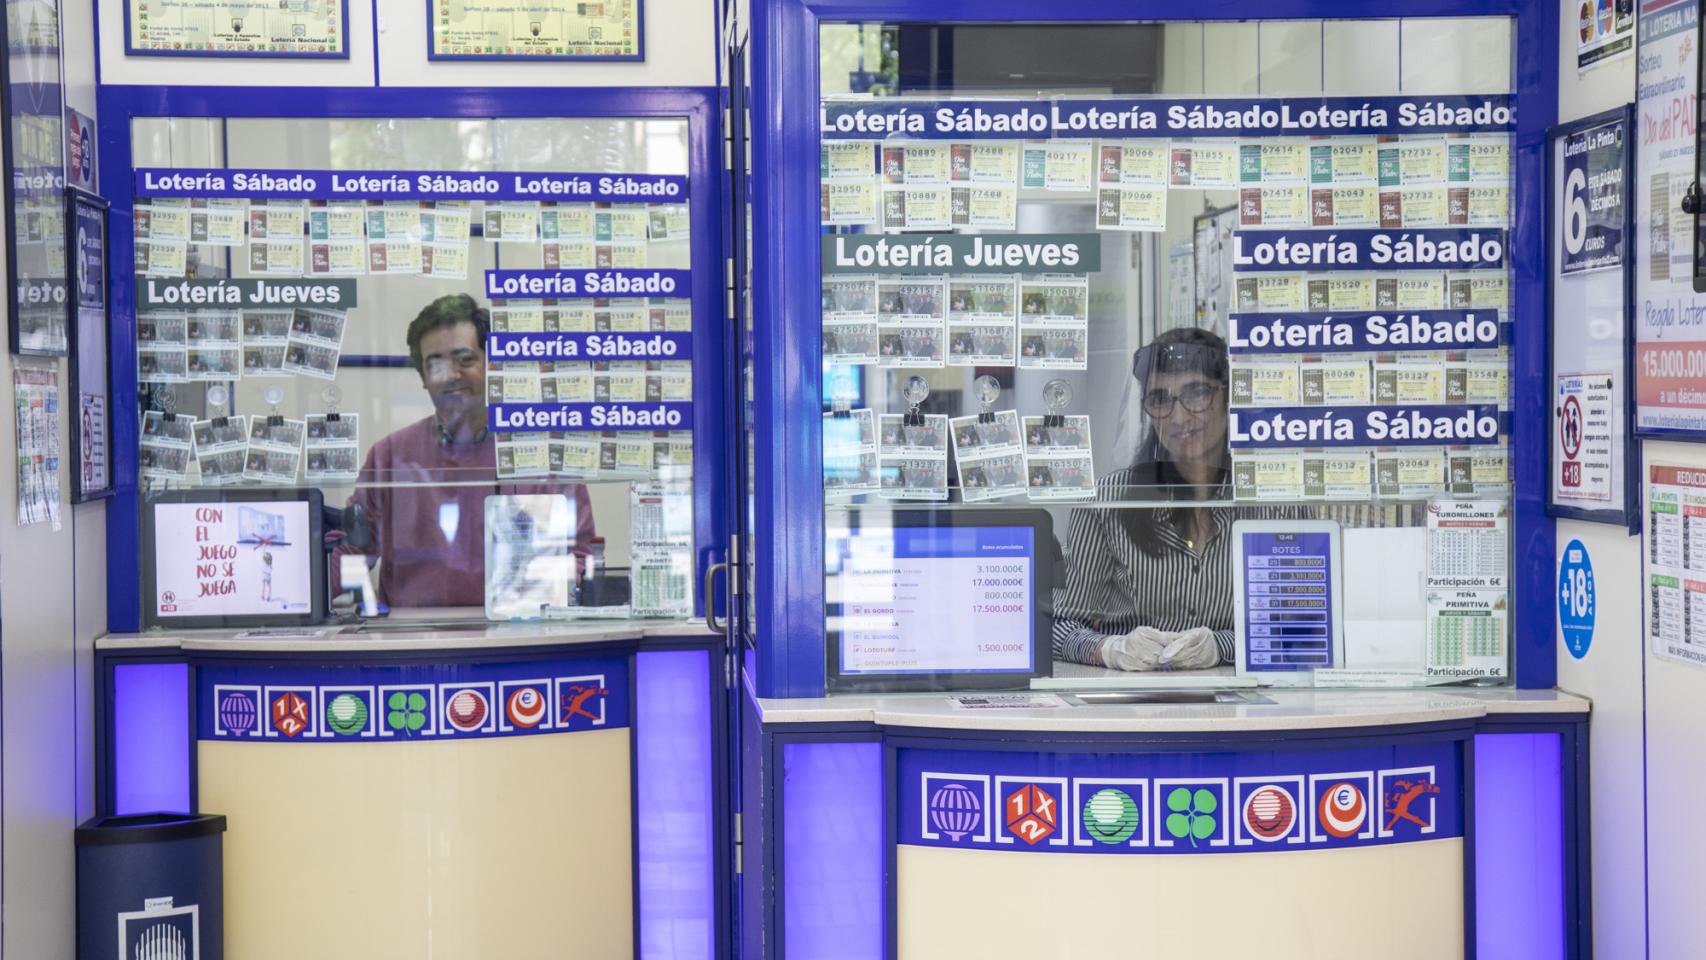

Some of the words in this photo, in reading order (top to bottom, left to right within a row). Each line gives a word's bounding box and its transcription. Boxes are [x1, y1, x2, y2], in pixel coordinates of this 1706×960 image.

[820, 108, 925, 132] Lotería
[935, 108, 1048, 132] Sábado
[1052, 105, 1157, 130] Lotería
[1166, 104, 1279, 130] Sábado
[1281, 104, 1388, 128] Lotería
[1398, 102, 1511, 126] Sábado
[1588, 136, 1596, 150] La
[1597, 131, 1614, 148] Pinta
[906, 148, 936, 157] 10889
[1046, 152, 1078, 160] 40217
[1262, 146, 1293, 154] 67414
[145, 172, 226, 191] Lotería
[232, 172, 316, 192] Sábado
[332, 174, 410, 192] Lotería
[417, 174, 500, 194] Sábado
[514, 176, 592, 195] Lotería
[598, 178, 680, 196] Sábado
[907, 192, 936, 200] 10889
[1262, 189, 1293, 197] 67414
[1334, 189, 1364, 197] 62043
[1616, 194, 1620, 206] A
[1564, 168, 1586, 254] 6
[836, 236, 953, 266] Lotería
[963, 237, 1080, 266] Jueves
[1233, 235, 1358, 265] Lotería
[1370, 234, 1502, 262] Sábado
[488, 272, 577, 294] Lotería
[584, 272, 676, 294] Sábado
[148, 280, 242, 304] Lotería
[248, 282, 342, 304] Jueves
[1229, 316, 1354, 347] Lotería
[1365, 314, 1497, 345] Sábado
[490, 336, 578, 357] Lotería
[585, 336, 678, 356] Sábado
[1642, 350, 1706, 378] 15.000.00
[1660, 391, 1665, 403] a
[1667, 391, 1676, 403] un
[495, 406, 583, 427] Lotería
[590, 405, 682, 426] Sábado
[1230, 411, 1355, 442] Lotería
[1366, 410, 1498, 440] Sábado
[1564, 464, 1579, 484] +18
[196, 507, 223, 523] CON
[196, 526, 210, 541] EL
[196, 545, 237, 561] JUEGO
[1272, 546, 1301, 554] BOTES
[196, 563, 217, 579] NO
[222, 562, 234, 577] SE
[976, 564, 1024, 573] 3.100.000€
[197, 580, 237, 597] JUEGA
[972, 578, 1024, 586] 17.000.000€
[1428, 577, 1485, 587] Participación
[984, 591, 1024, 599] 800.000€
[1562, 568, 1587, 617] +18
[972, 604, 1024, 613] 17.500.000€
[978, 643, 1024, 652] 1.500.000€
[1428, 667, 1485, 677] Participación
[1490, 668, 1501, 676] 6€
